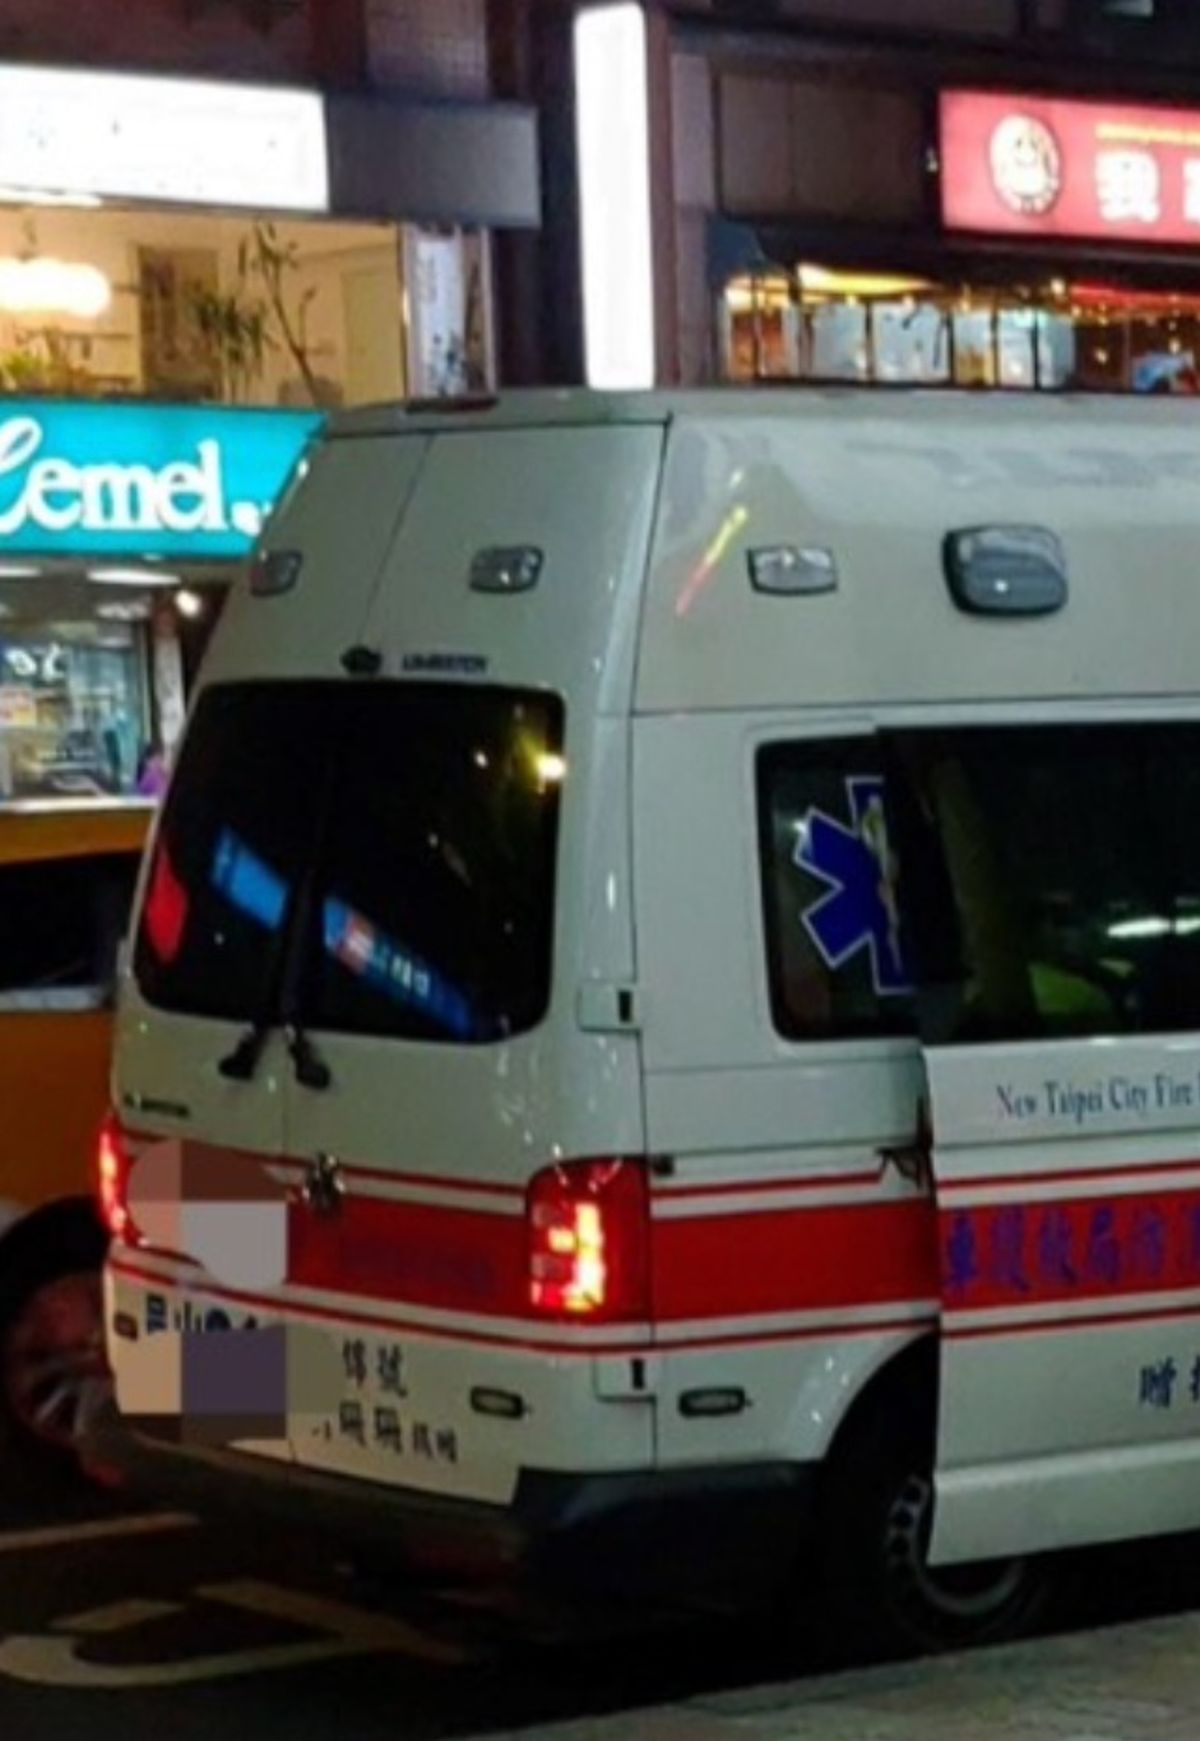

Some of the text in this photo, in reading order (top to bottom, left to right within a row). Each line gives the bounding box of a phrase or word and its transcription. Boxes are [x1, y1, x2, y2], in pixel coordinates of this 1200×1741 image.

[996, 1083, 1037, 1118] New
[1045, 1079, 1102, 1124] Taipei
[1109, 1075, 1148, 1116] City
[1154, 1073, 1191, 1109] Fire
